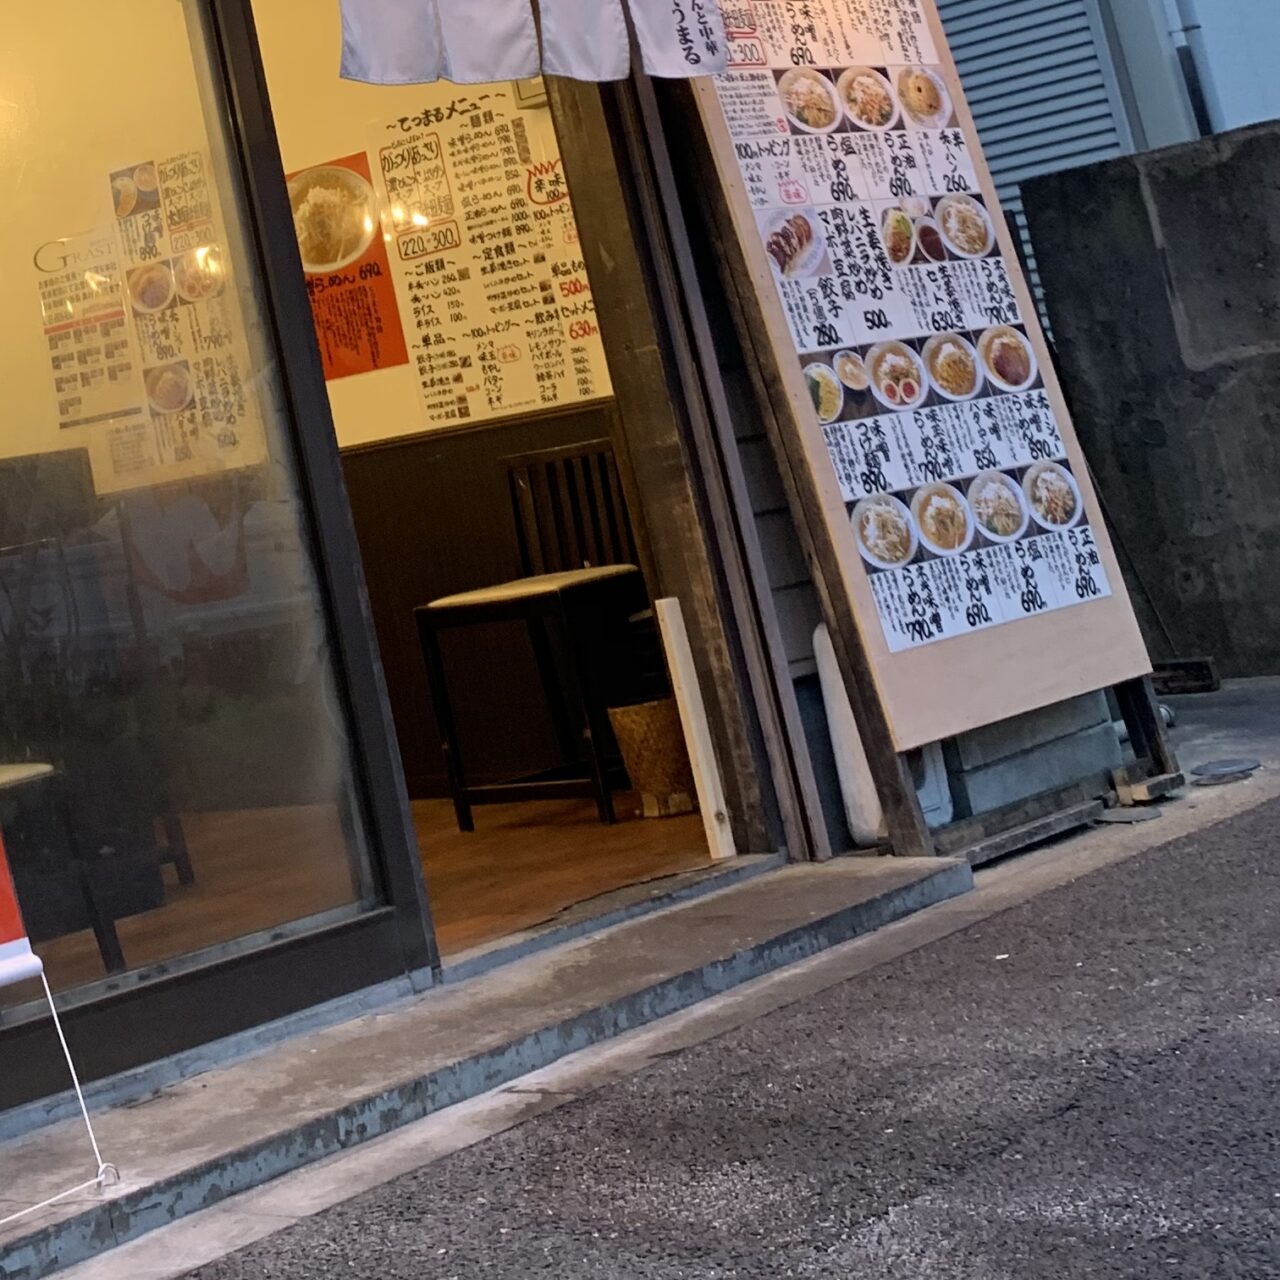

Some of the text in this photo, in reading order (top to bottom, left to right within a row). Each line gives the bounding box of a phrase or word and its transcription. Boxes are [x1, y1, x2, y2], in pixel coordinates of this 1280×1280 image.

[798, 3, 818, 42] 味噌
[839, 136, 857, 156] 塩
[951, 130, 965, 151] 半
[926, 269, 944, 305] セット
[1022, 392, 1042, 433] 味噌
[1026, 539, 1043, 562] 塩
[971, 550, 992, 595] 味噌
